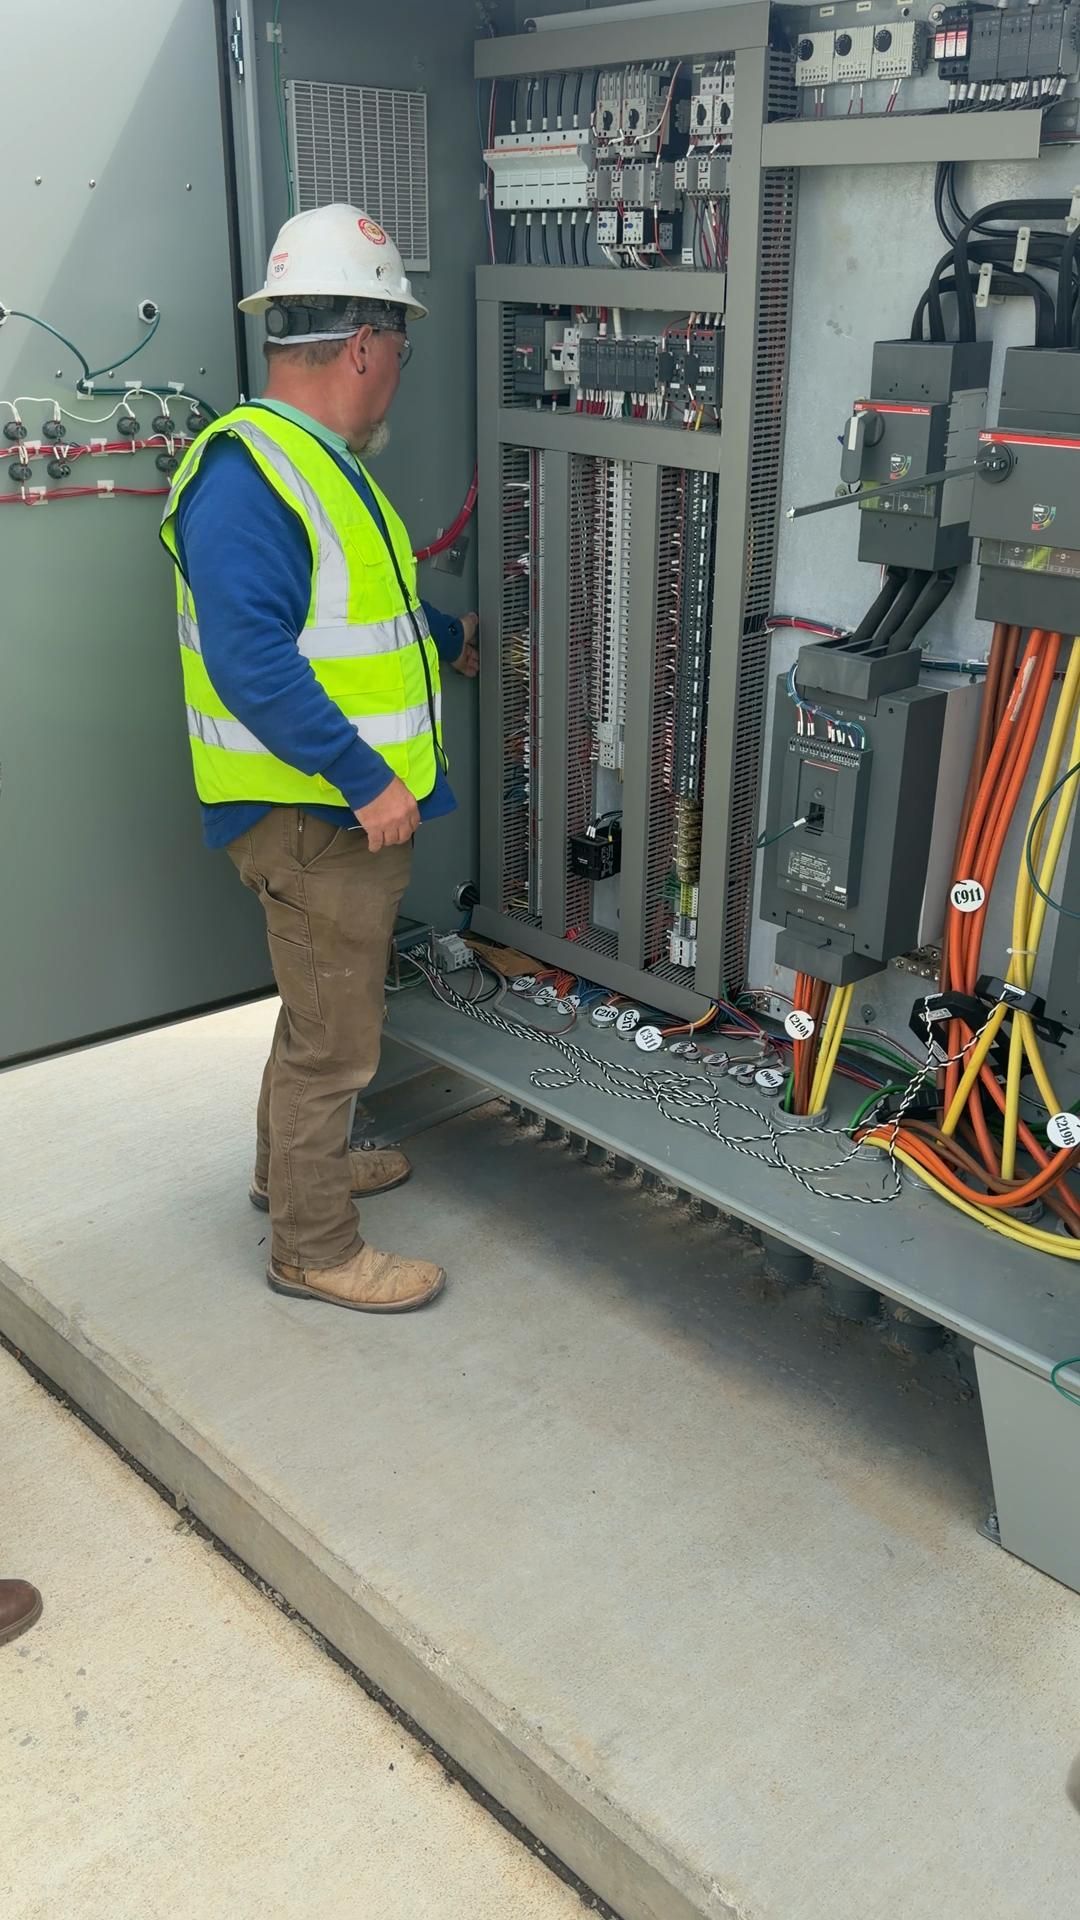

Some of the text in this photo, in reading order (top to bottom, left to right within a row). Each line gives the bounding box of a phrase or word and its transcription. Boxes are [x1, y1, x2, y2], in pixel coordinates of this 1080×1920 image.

[954, 887, 982, 904] C911
[595, 1008, 617, 1018] C218
[789, 1014, 809, 1037] C219A
[640, 1028, 658, 1049] C311
[1055, 1115, 1075, 1145] C219B
